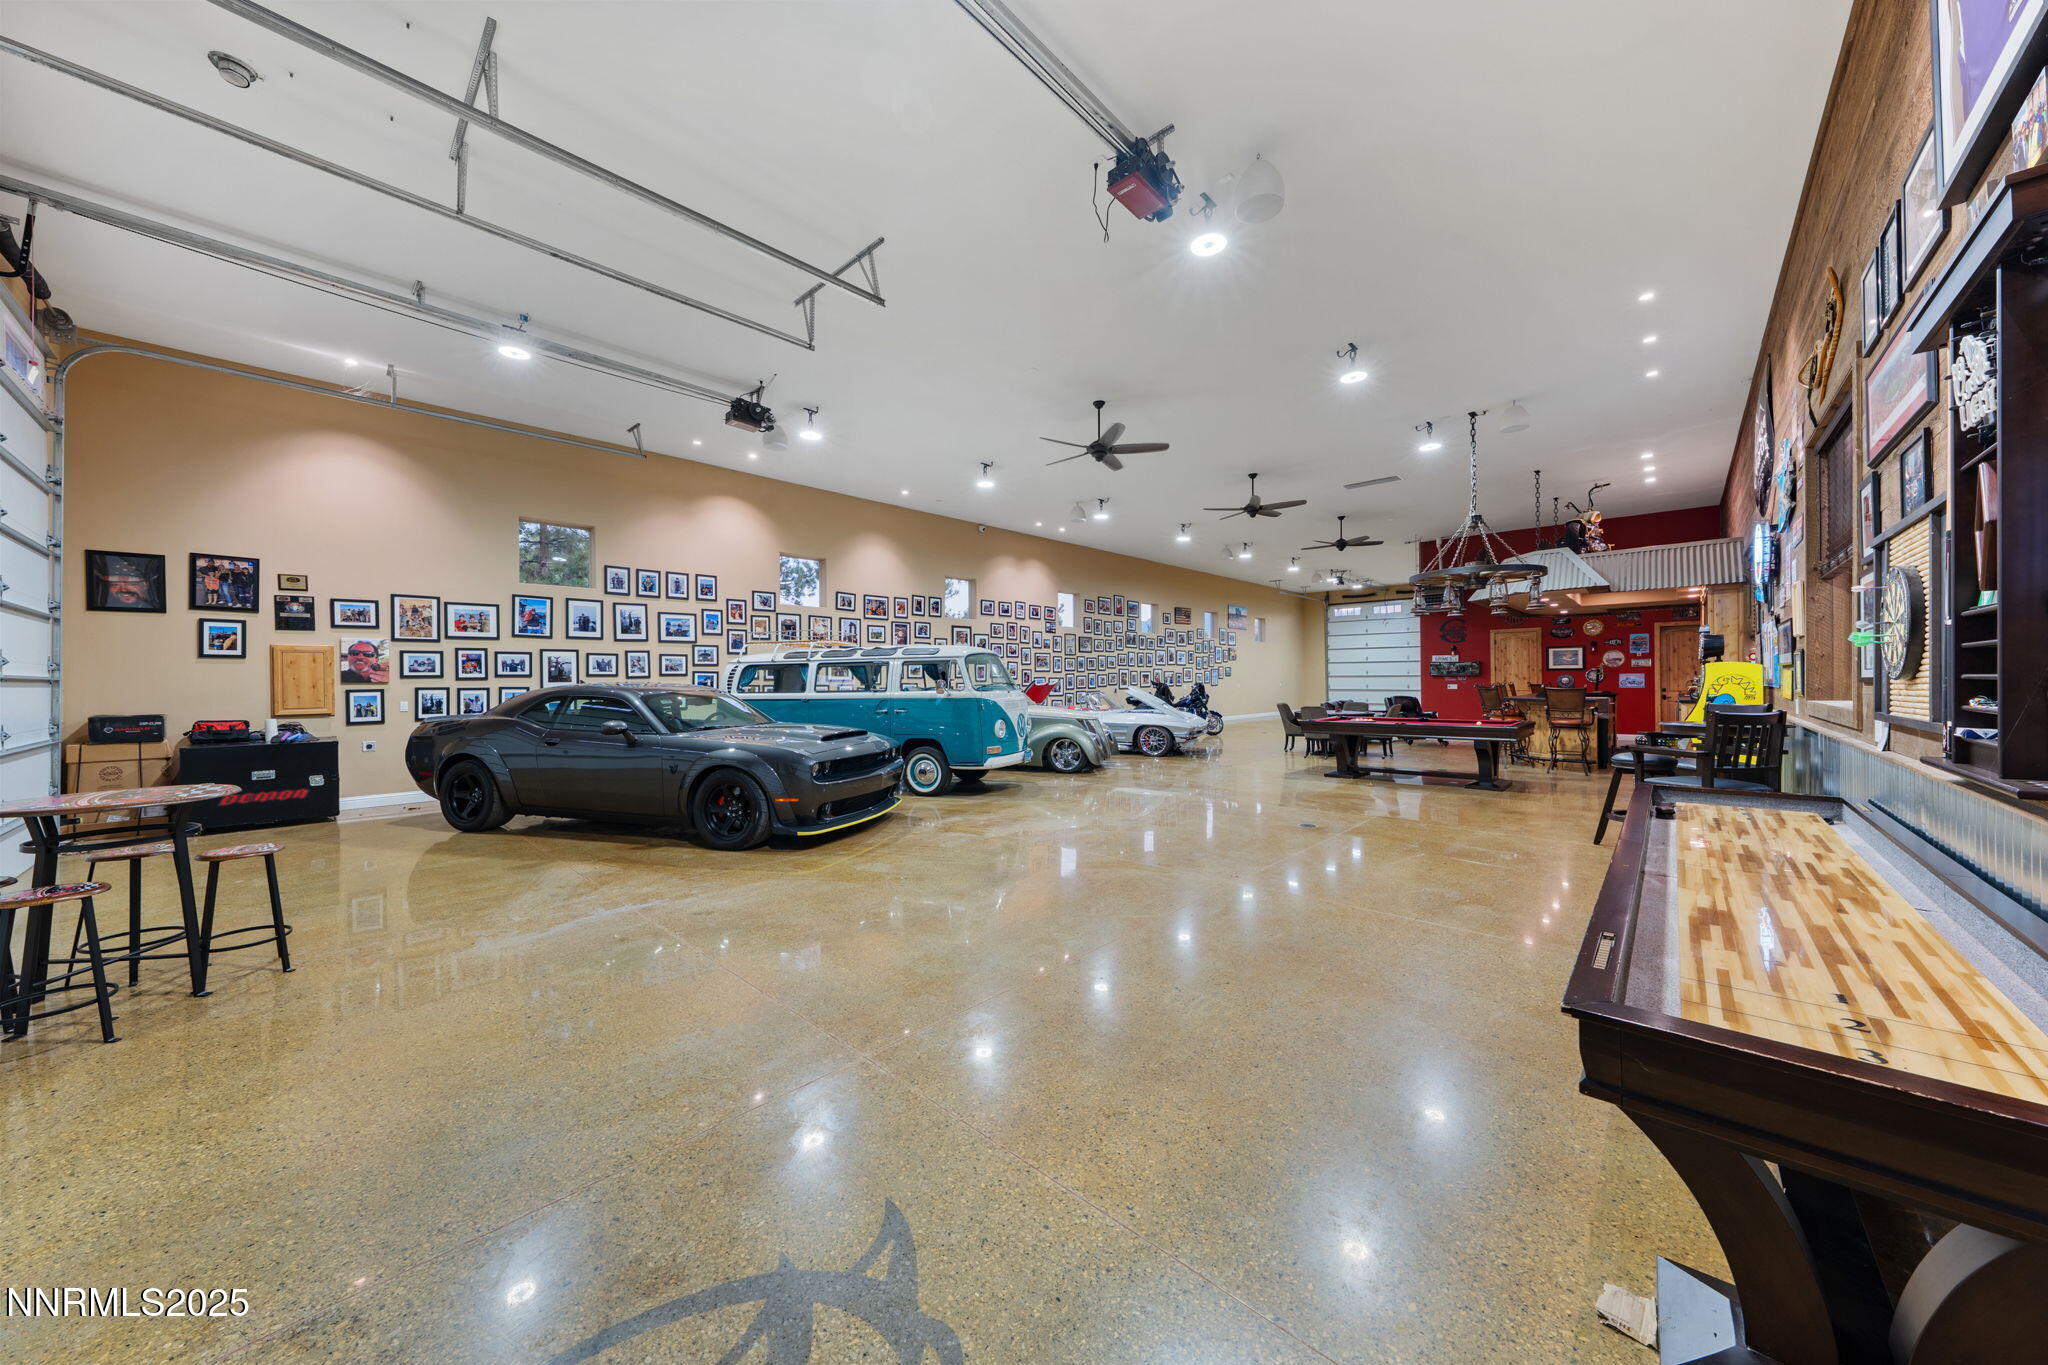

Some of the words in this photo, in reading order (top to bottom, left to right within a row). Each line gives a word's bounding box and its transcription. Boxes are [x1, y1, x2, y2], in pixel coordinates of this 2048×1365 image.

[218, 788, 309, 806] DEMON
[1835, 993, 1849, 1005] 1
[1840, 1018, 1871, 1033] 2
[1856, 1048, 1888, 1064] 3
